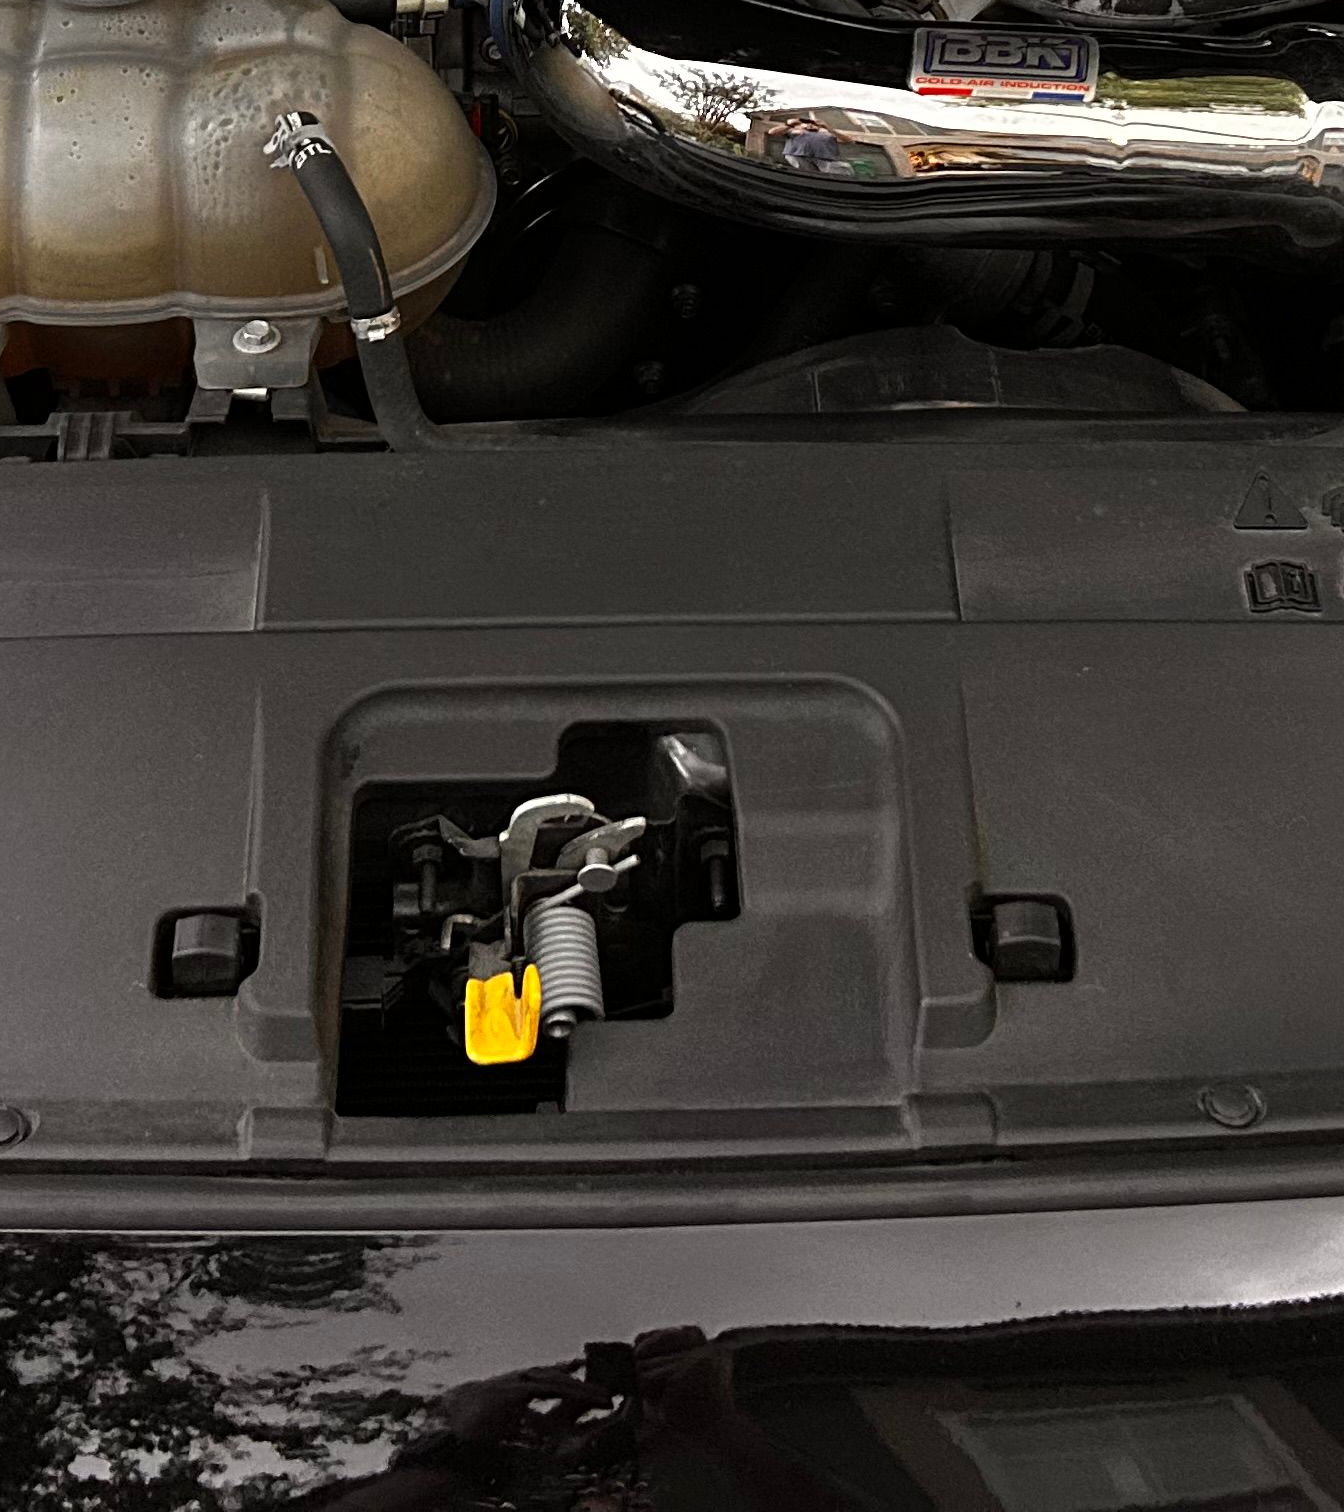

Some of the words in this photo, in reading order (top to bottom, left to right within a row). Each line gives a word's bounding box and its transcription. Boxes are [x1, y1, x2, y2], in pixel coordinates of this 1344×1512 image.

[940, 35, 1067, 69] BBK
[915, 76, 994, 87] COLD-AIR
[1000, 80, 1090, 92] INDUCTION
